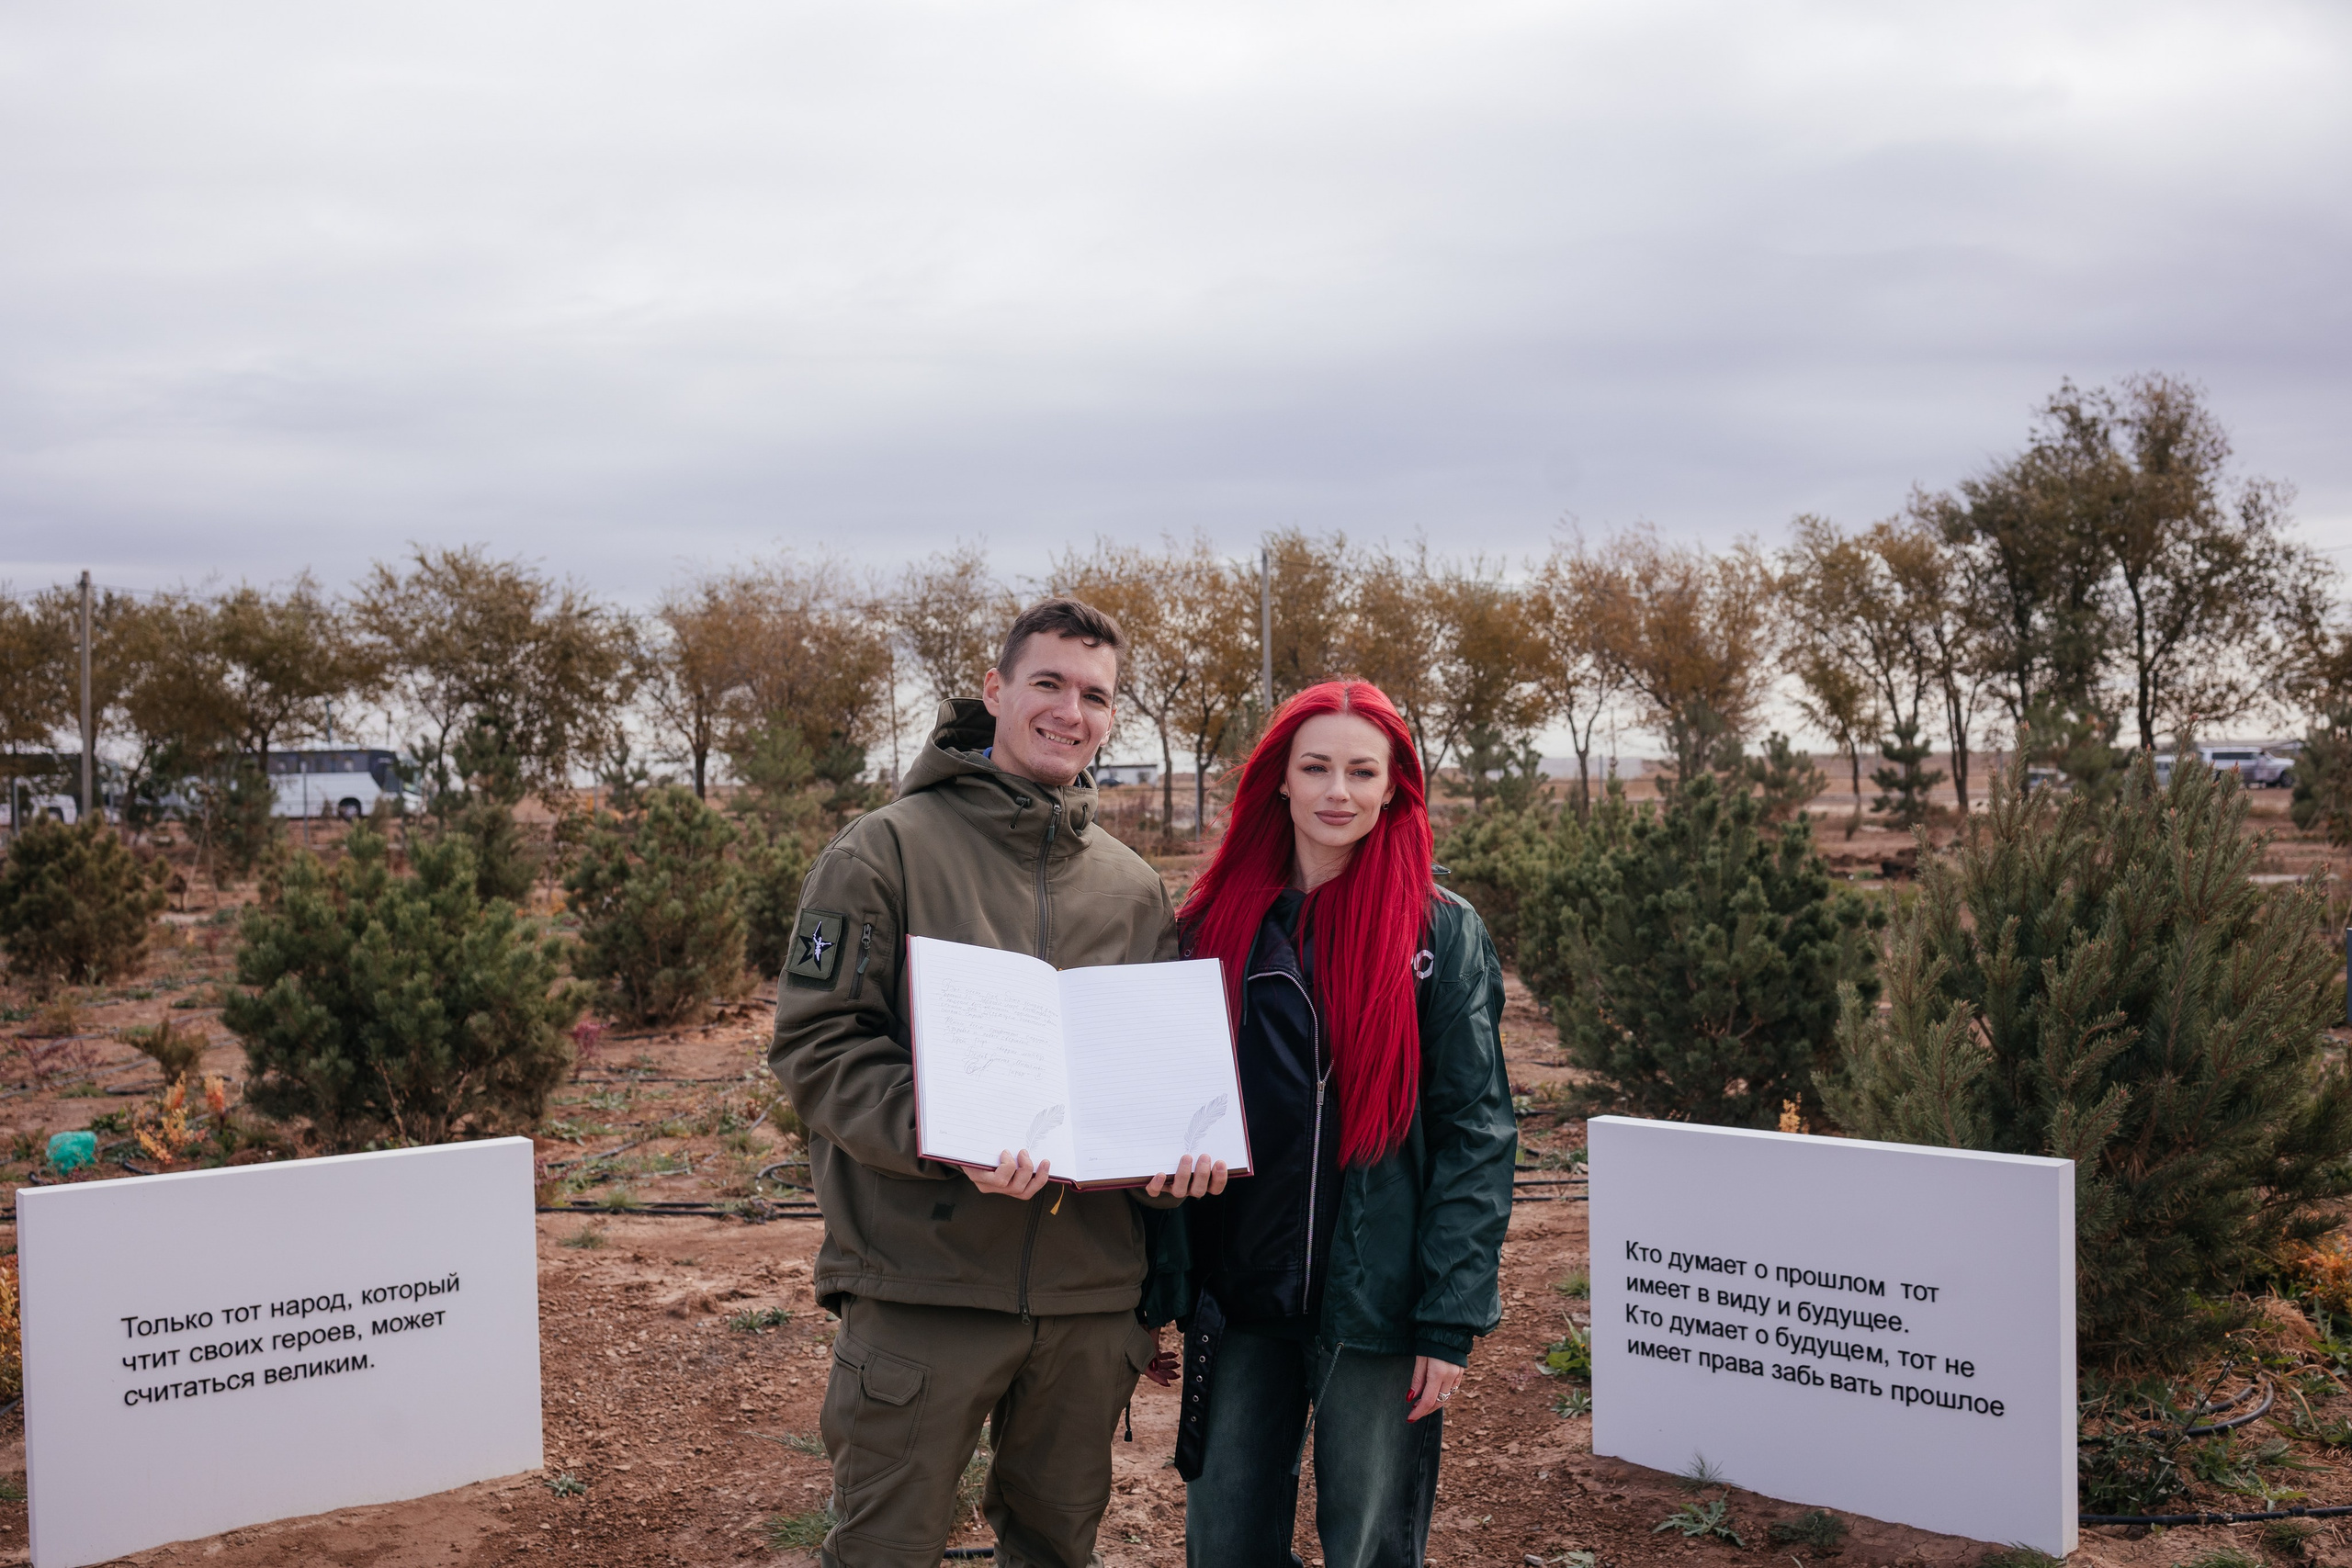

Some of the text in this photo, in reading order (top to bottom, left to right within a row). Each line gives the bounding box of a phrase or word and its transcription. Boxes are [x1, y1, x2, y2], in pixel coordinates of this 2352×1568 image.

[1625, 1240, 1940, 1303] Кто думает о прошлом тот
[120, 1271, 459, 1338] Только тот народ, который
[1626, 1276, 1909, 1334] имеет в виду и будущее.
[122, 1310, 447, 1371] чтит своих героев, может
[1625, 1303, 1975, 1379] Кто думает о будущем, тот не
[123, 1354, 375, 1406] считаться великим.
[1627, 1338, 1692, 1364] имеет
[1698, 1350, 1765, 1377] права
[1891, 1383, 2006, 1417] прошлое
